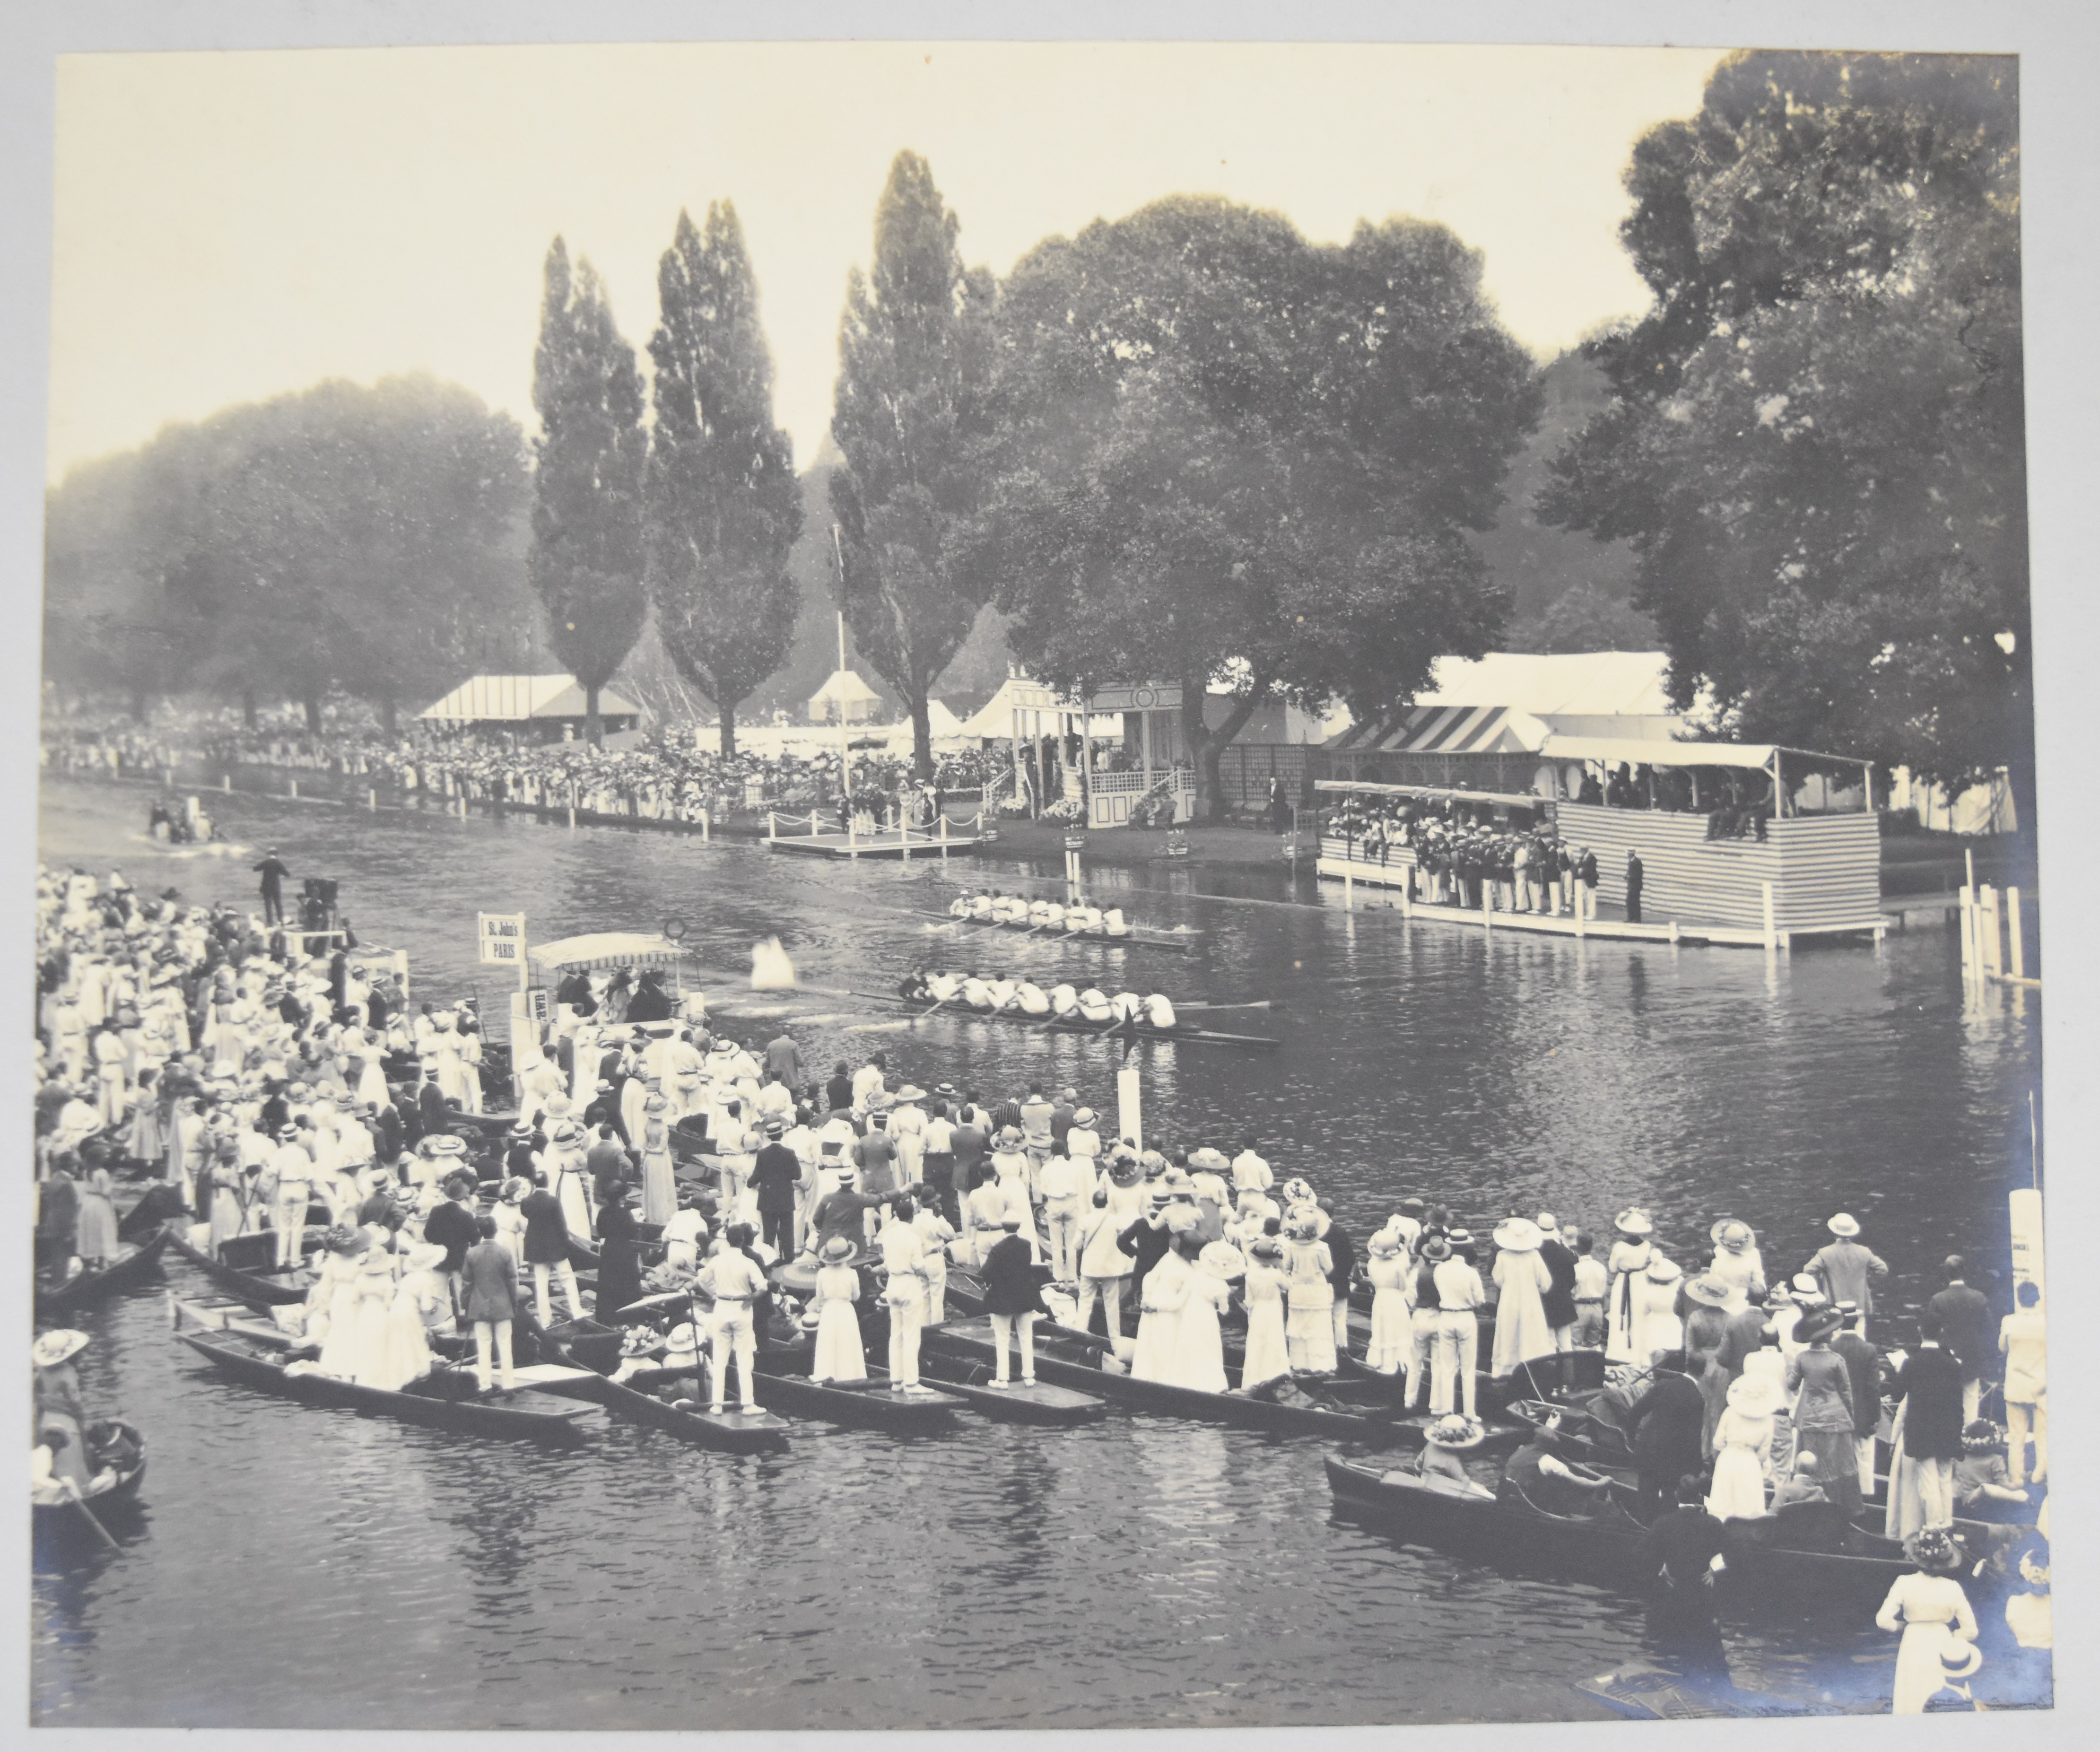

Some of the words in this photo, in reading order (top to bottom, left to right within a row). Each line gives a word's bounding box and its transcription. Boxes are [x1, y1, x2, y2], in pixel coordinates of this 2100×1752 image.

[488, 922, 497, 936] St.
[499, 922, 518, 936] John's
[494, 943, 515, 958] PARIS
